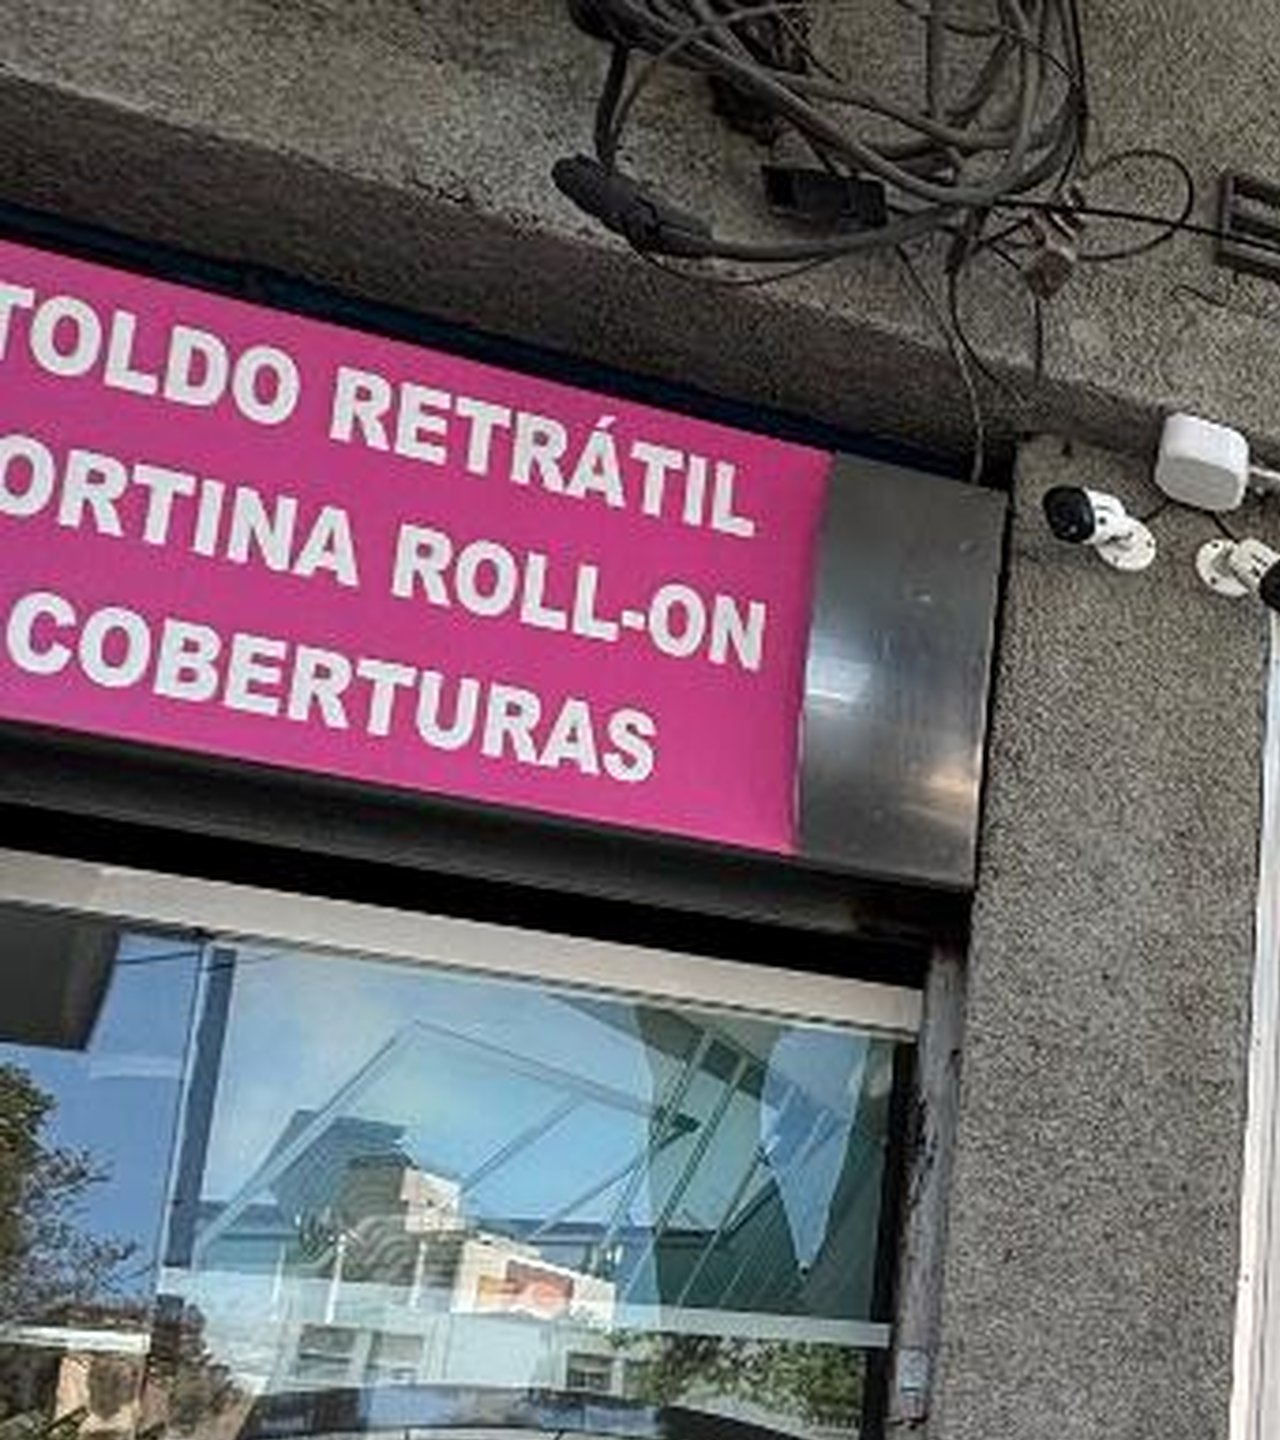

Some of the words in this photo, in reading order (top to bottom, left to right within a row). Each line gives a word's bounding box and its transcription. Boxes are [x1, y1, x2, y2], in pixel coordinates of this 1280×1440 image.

[0, 281, 300, 426] TOLDO
[328, 365, 757, 538] RETRÁTIL
[5, 592, 656, 783] COBERTURAS
[391, 524, 766, 672] ROLL-ON
